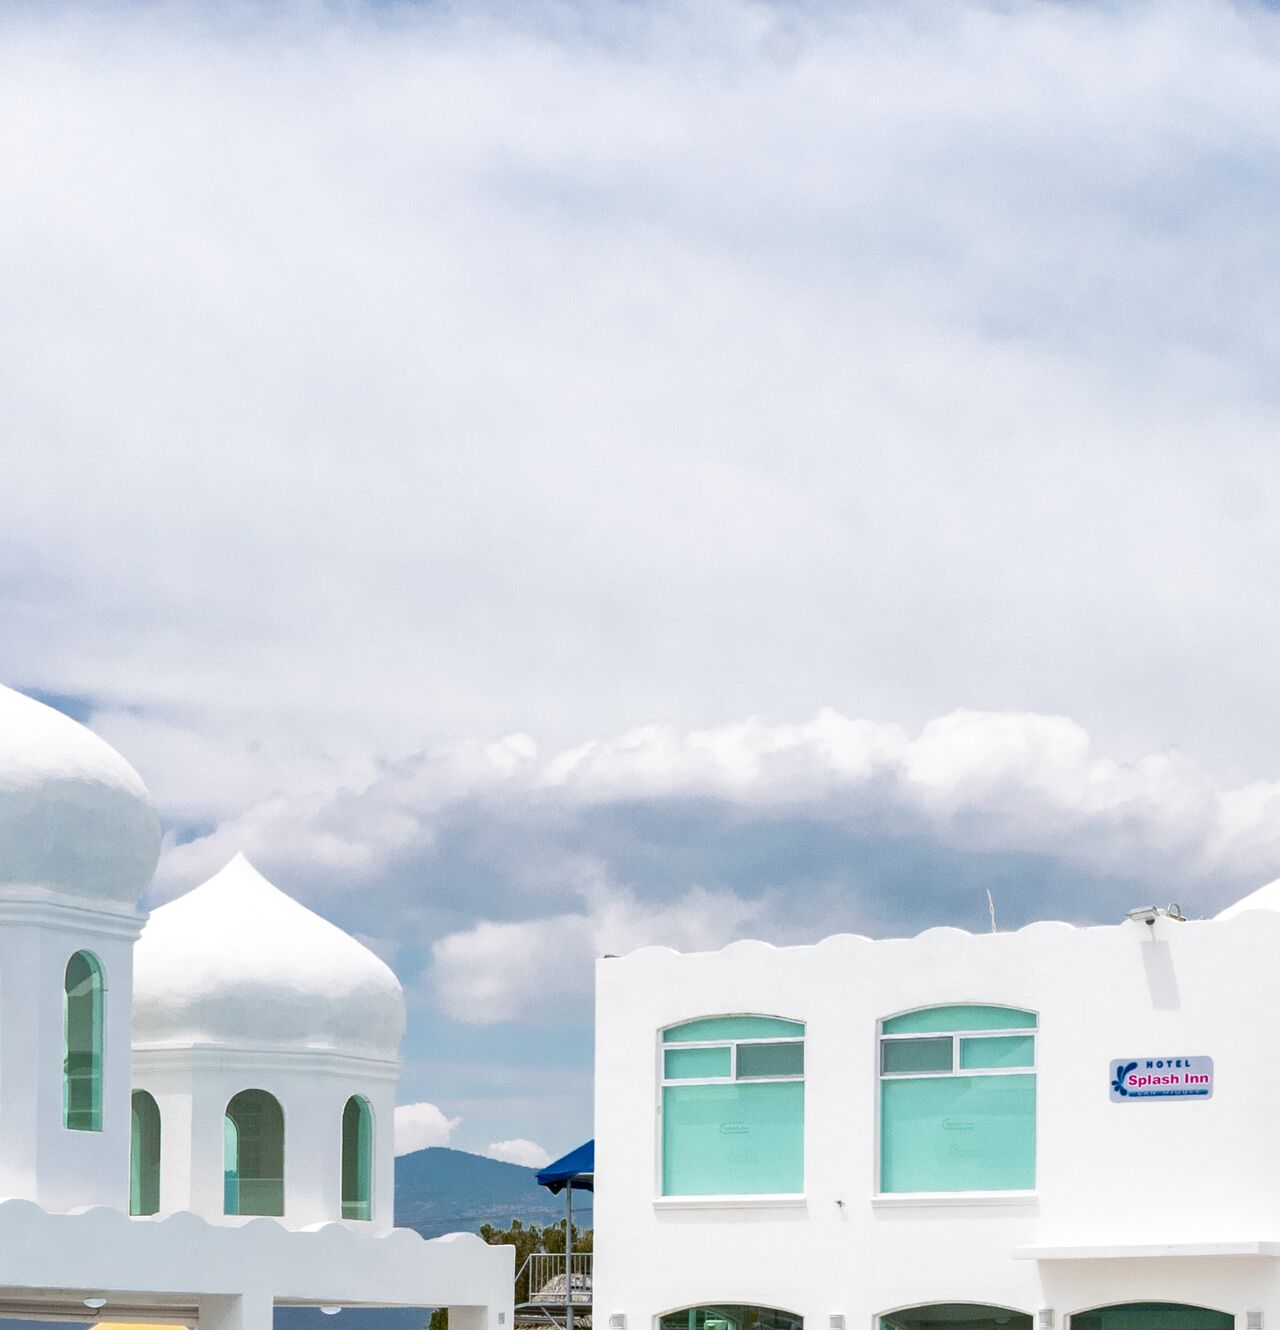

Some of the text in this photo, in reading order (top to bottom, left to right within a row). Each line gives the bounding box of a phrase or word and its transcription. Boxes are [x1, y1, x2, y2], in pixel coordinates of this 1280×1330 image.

[1146, 1060, 1191, 1068] HOTEL
[1128, 1073, 1210, 1088] Splash Inn
